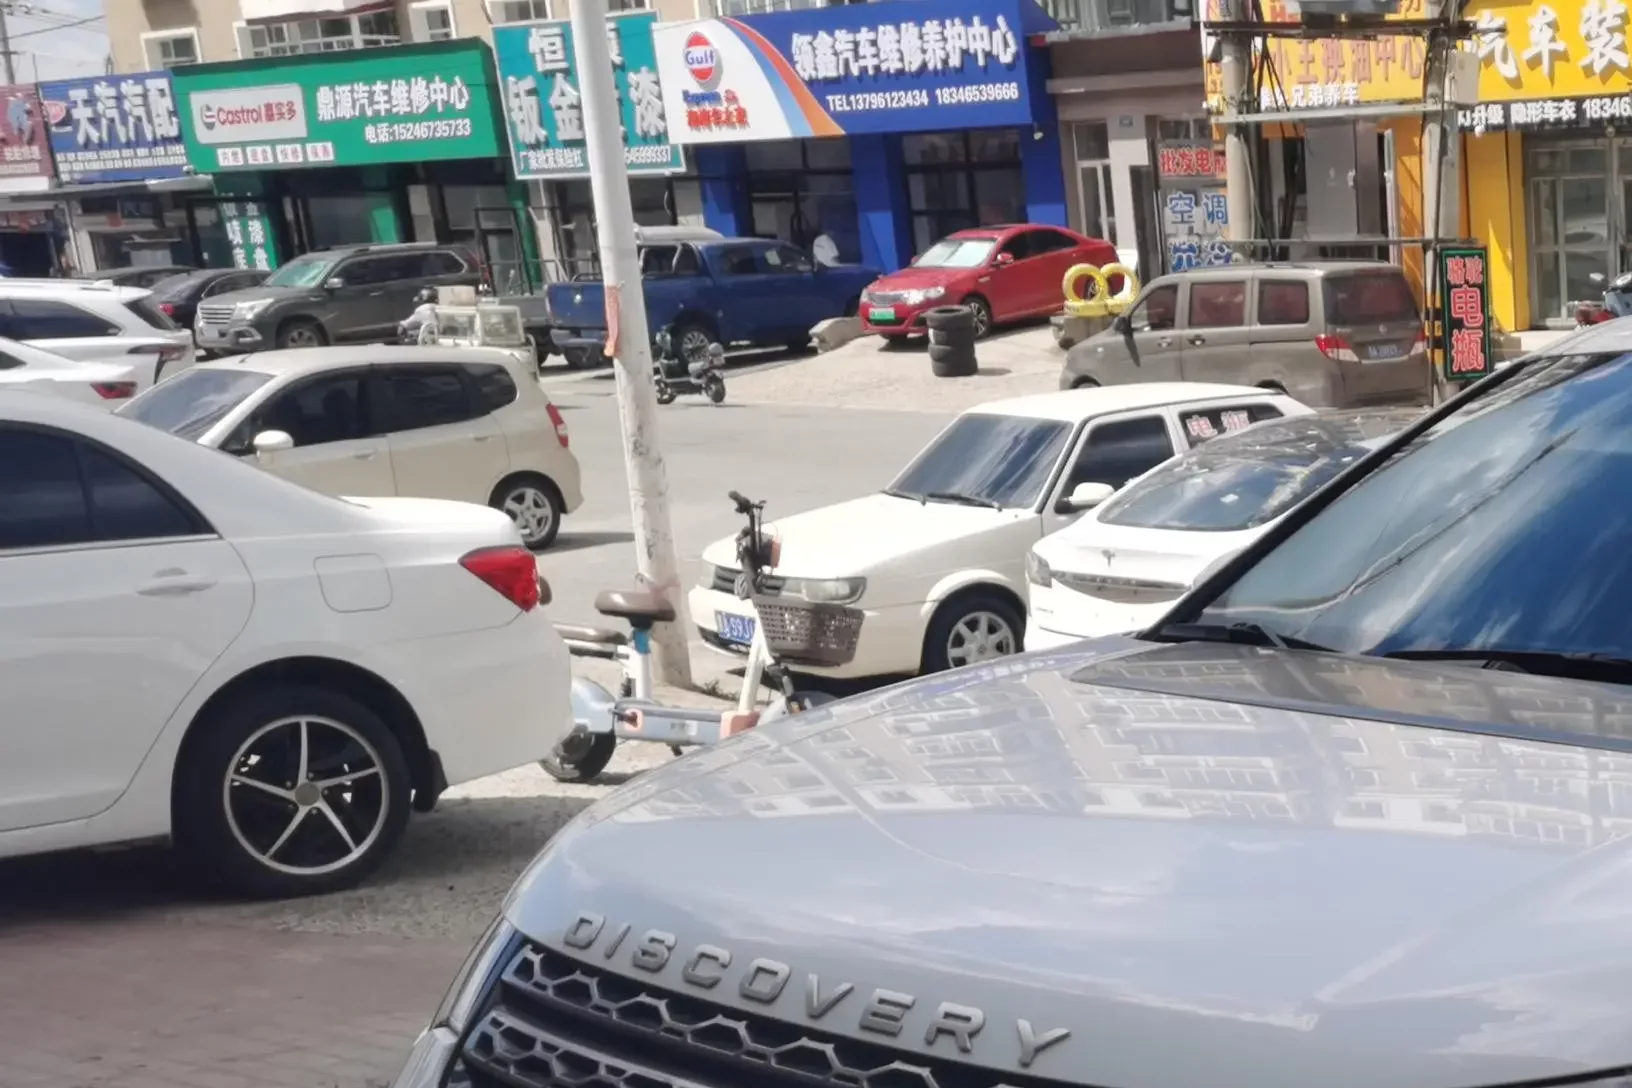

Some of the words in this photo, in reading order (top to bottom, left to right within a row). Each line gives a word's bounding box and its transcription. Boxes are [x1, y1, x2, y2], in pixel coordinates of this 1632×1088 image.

[685, 53, 715, 66] Gulf
[316, 76, 470, 122] 鼎源汽车维修中心
[507, 66, 667, 147] 钣金漆
[935, 82, 1019, 105] 18346539666
[216, 105, 263, 126] Castrol
[264, 101, 298, 122] 嘉实多
[1168, 192, 1228, 224] 空调
[563, 910, 1071, 1068] DISCOVERY
